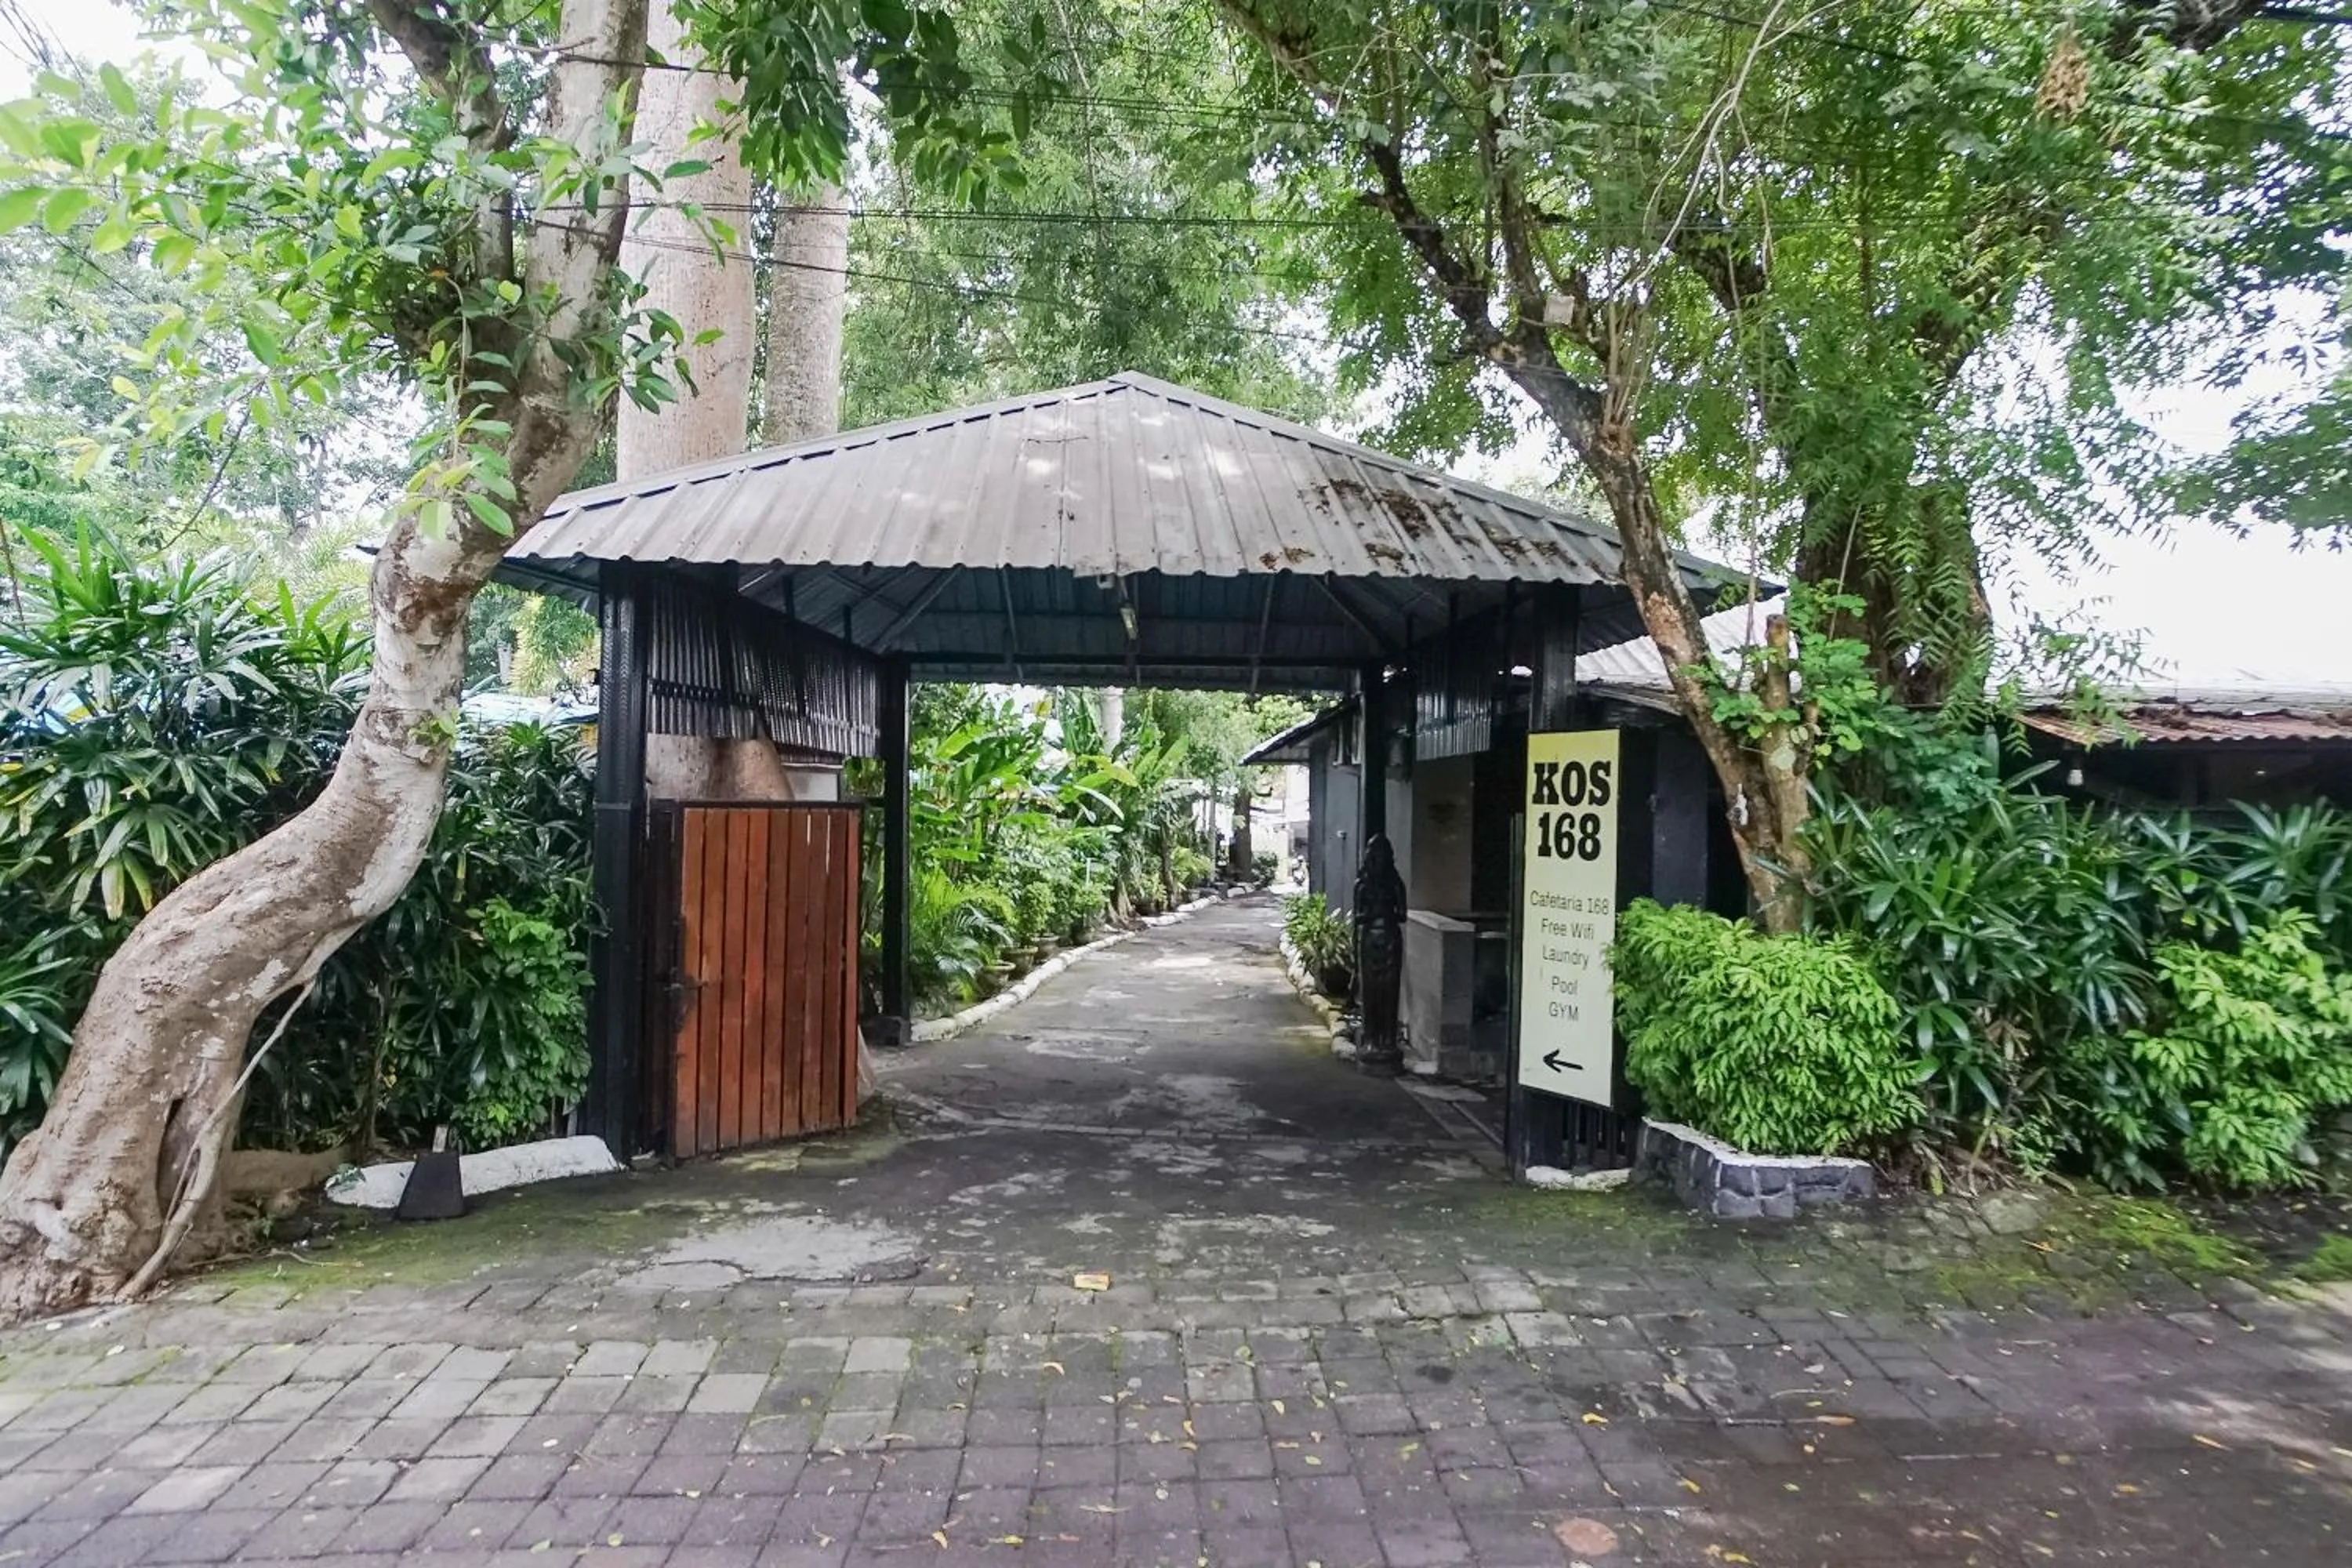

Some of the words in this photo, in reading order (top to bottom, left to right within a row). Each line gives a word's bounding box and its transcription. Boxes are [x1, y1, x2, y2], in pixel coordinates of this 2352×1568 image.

[1532, 760, 1611, 806] KOS
[1537, 812, 1601, 861] 168
[1587, 898, 1610, 915] 168
[1541, 918, 1568, 936] Free
[1570, 923, 1595, 940] Wifi
[1542, 945, 1589, 971] Laundry
[1552, 976, 1578, 995] Pool
[1549, 1001, 1579, 1021] GYM
